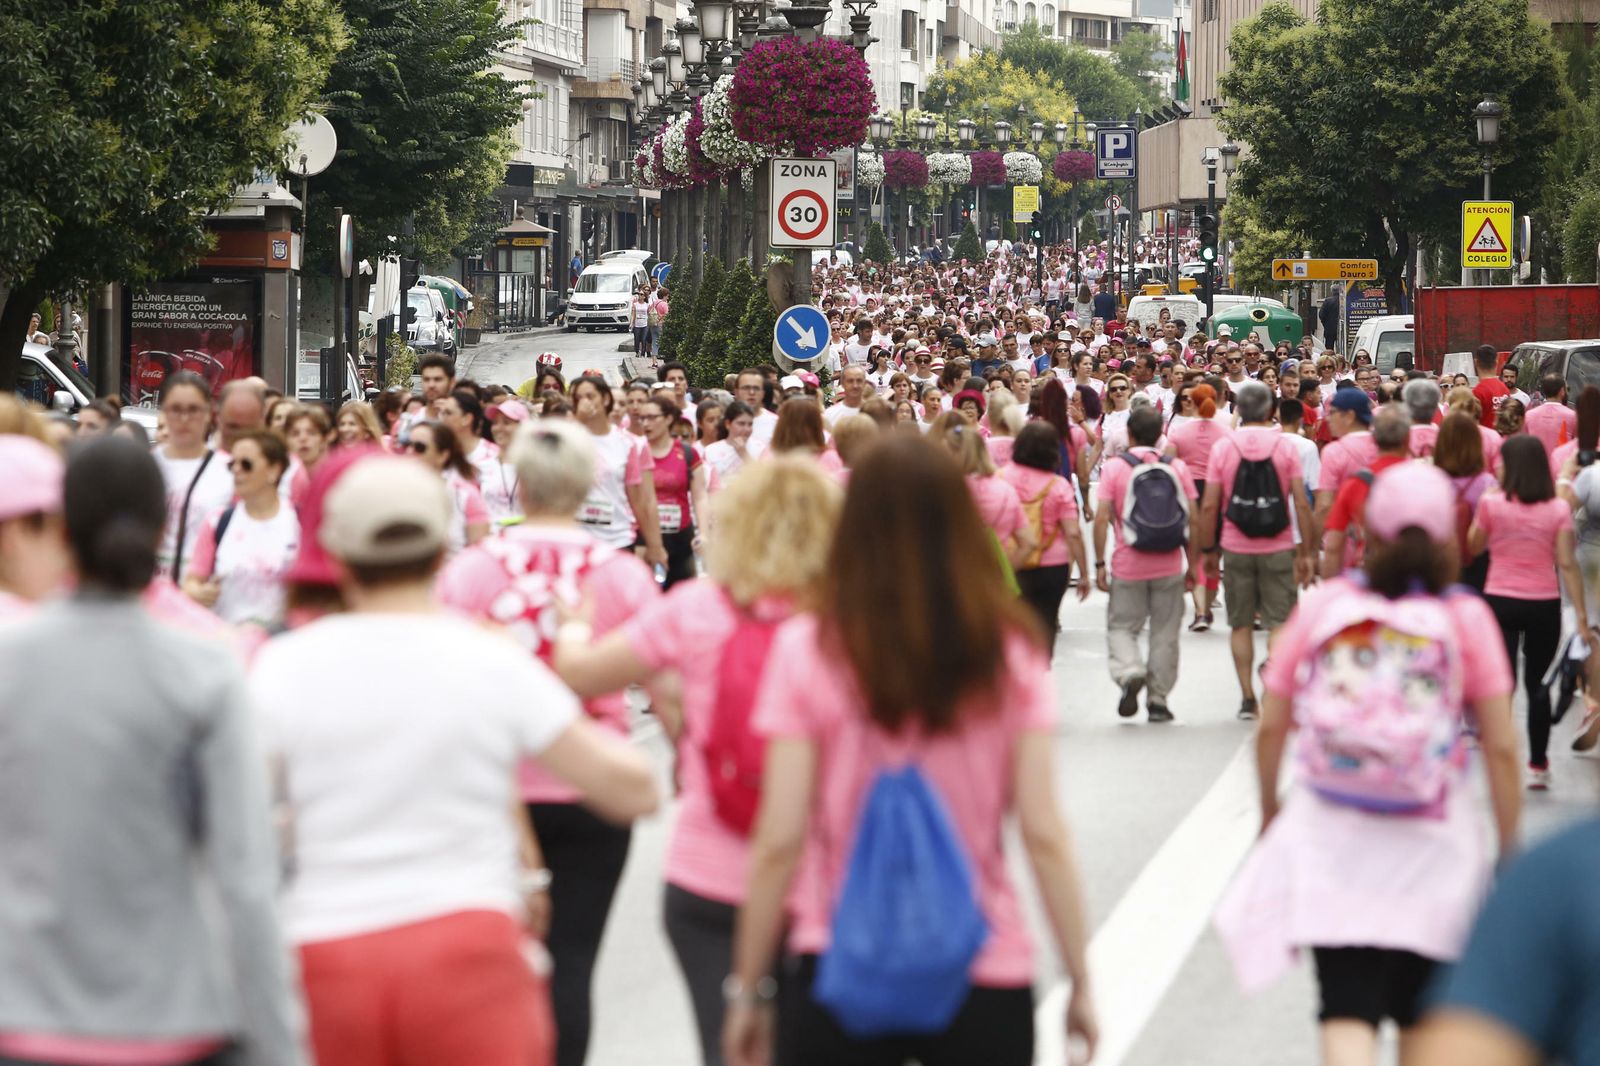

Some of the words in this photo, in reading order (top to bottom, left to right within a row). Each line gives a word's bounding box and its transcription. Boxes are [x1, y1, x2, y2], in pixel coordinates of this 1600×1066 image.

[1105, 134, 1128, 158] P
[780, 164, 828, 177] ZONA
[790, 206, 818, 223] 30
[1467, 255, 1508, 263] COLEGIO
[1340, 270, 1367, 278] Dauro
[132, 294, 143, 302] LA
[173, 295, 206, 303] BEBIDA
[132, 302, 187, 311] ENERGÉTICA
[188, 304, 207, 312] CON
[131, 311, 157, 319] GRAN
[158, 312, 189, 320] SABOR
[190, 312, 197, 320] A
[198, 312, 248, 321] COCA-COLA
[173, 321, 203, 330] ENERGÍA
